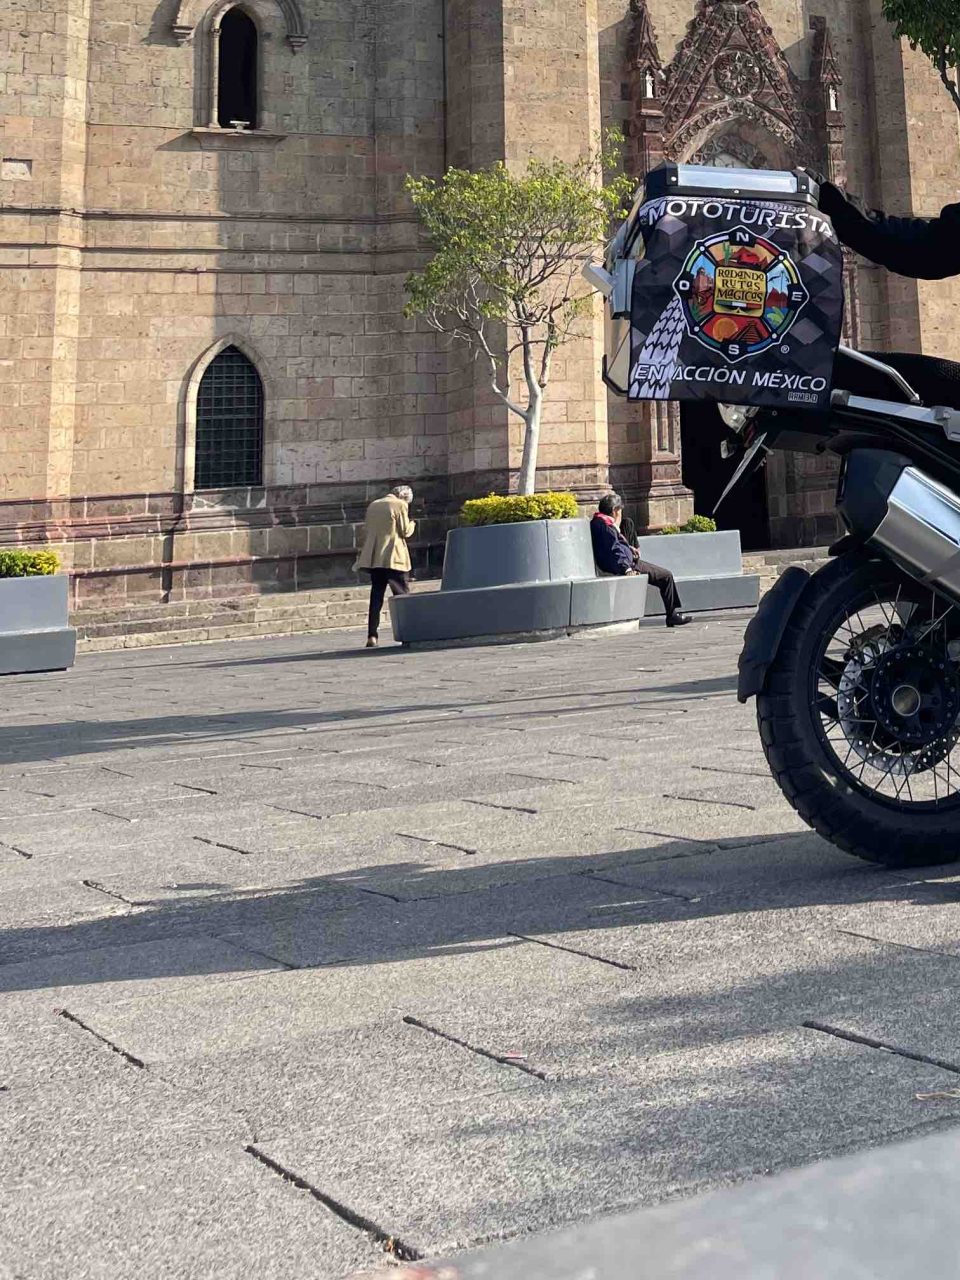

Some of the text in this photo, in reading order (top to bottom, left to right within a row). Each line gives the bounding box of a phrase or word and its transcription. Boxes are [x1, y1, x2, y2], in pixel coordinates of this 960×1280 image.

[648, 200, 833, 239] MOTOTURISTA
[736, 231, 750, 243] N
[791, 291, 803, 302] E
[728, 344, 740, 355] S
[634, 364, 827, 392] EN ACCIÓN MÉXICO
